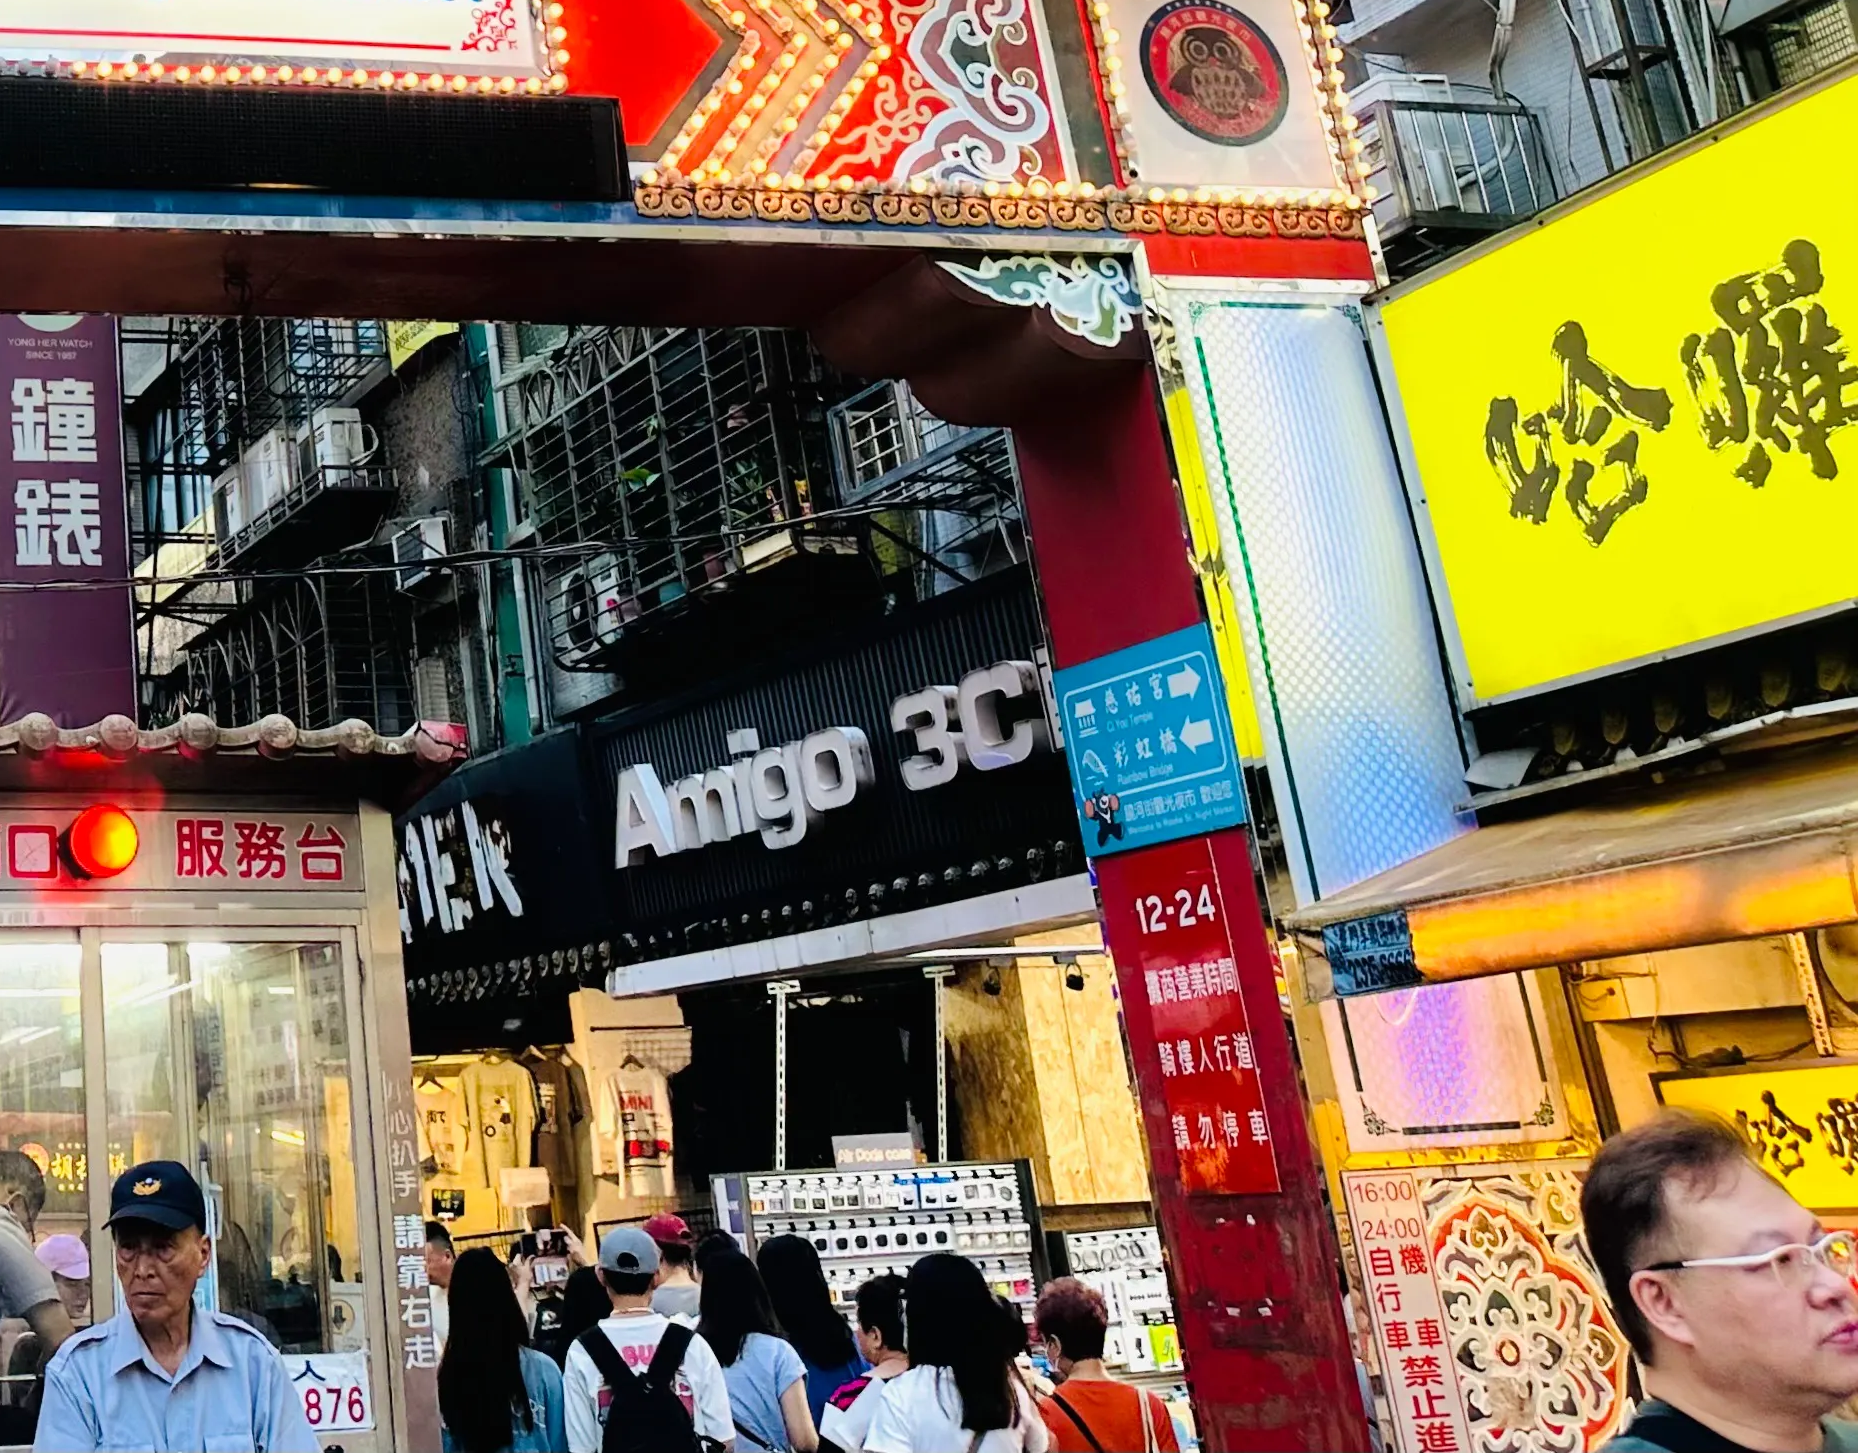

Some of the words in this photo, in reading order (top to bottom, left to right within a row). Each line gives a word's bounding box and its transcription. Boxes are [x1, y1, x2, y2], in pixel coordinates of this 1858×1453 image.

[8, 337, 36, 347] YONG
[37, 338, 57, 348] HER
[59, 338, 93, 349] WATCH
[25, 350, 54, 360] SINCE
[11, 377, 103, 567] 鐘錶
[1130, 710, 1154, 728] Temple
[614, 726, 875, 870] Amigo
[888, 659, 1044, 792] 3C
[1113, 726, 1178, 769] 彩虹橋
[1117, 768, 1148, 785] Rainbow
[174, 818, 348, 882] 服務台
[1135, 883, 1216, 935] 12-24
[1144, 956, 1239, 1006] 攤商營業時間
[1158, 1032, 1254, 1077] 騎樓人行道
[385, 1072, 418, 1199] 小心扒手
[1171, 1108, 1269, 1151] 請勿停車
[1352, 1179, 1413, 1204] 16:00
[1361, 1217, 1422, 1241] 24:00
[393, 1213, 437, 1371] 請靠右走
[1368, 1245, 1413, 1351] 自行車
[1397, 1243, 1444, 1350] 機車
[304, 1386, 366, 1426] 876
[1399, 1354, 1460, 1453] 禁止進
